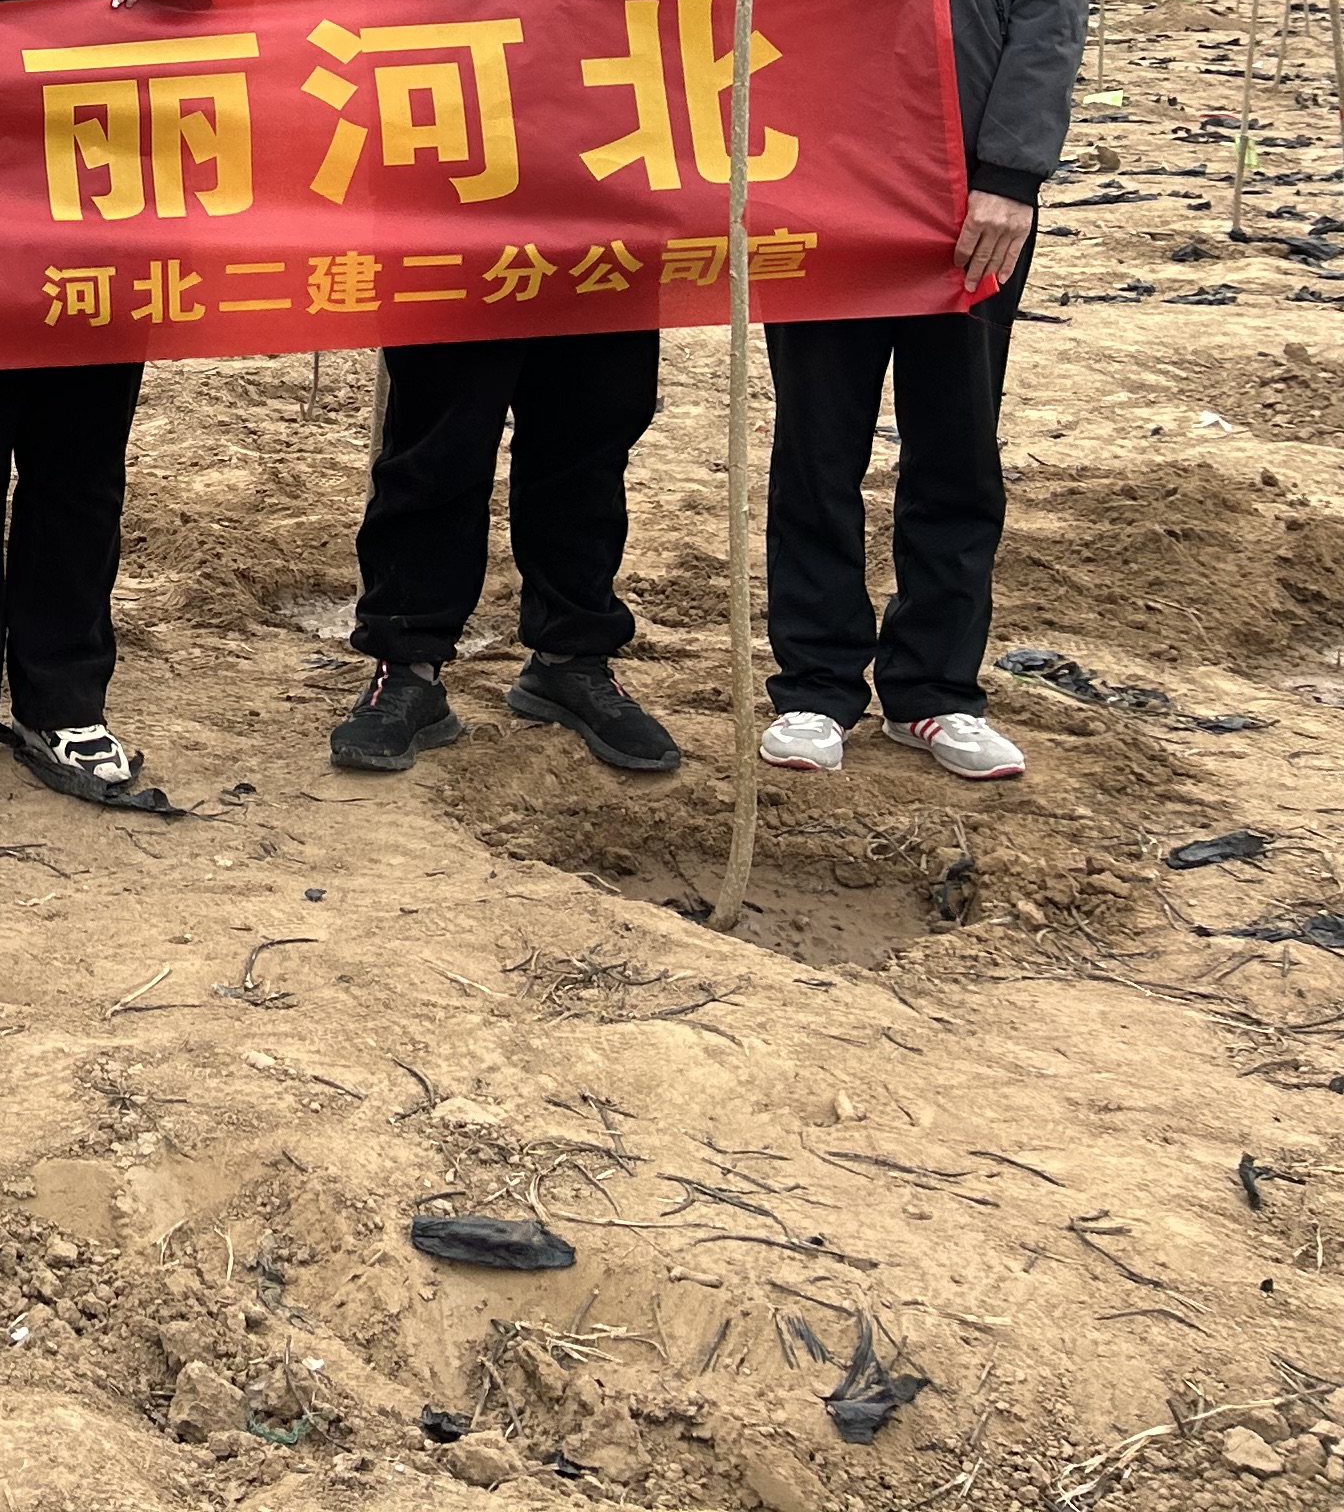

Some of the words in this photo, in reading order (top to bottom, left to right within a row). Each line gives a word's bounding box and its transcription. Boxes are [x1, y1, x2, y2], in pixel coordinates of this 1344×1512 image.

[43, 227, 818, 328] 河北二建二分公司宣
